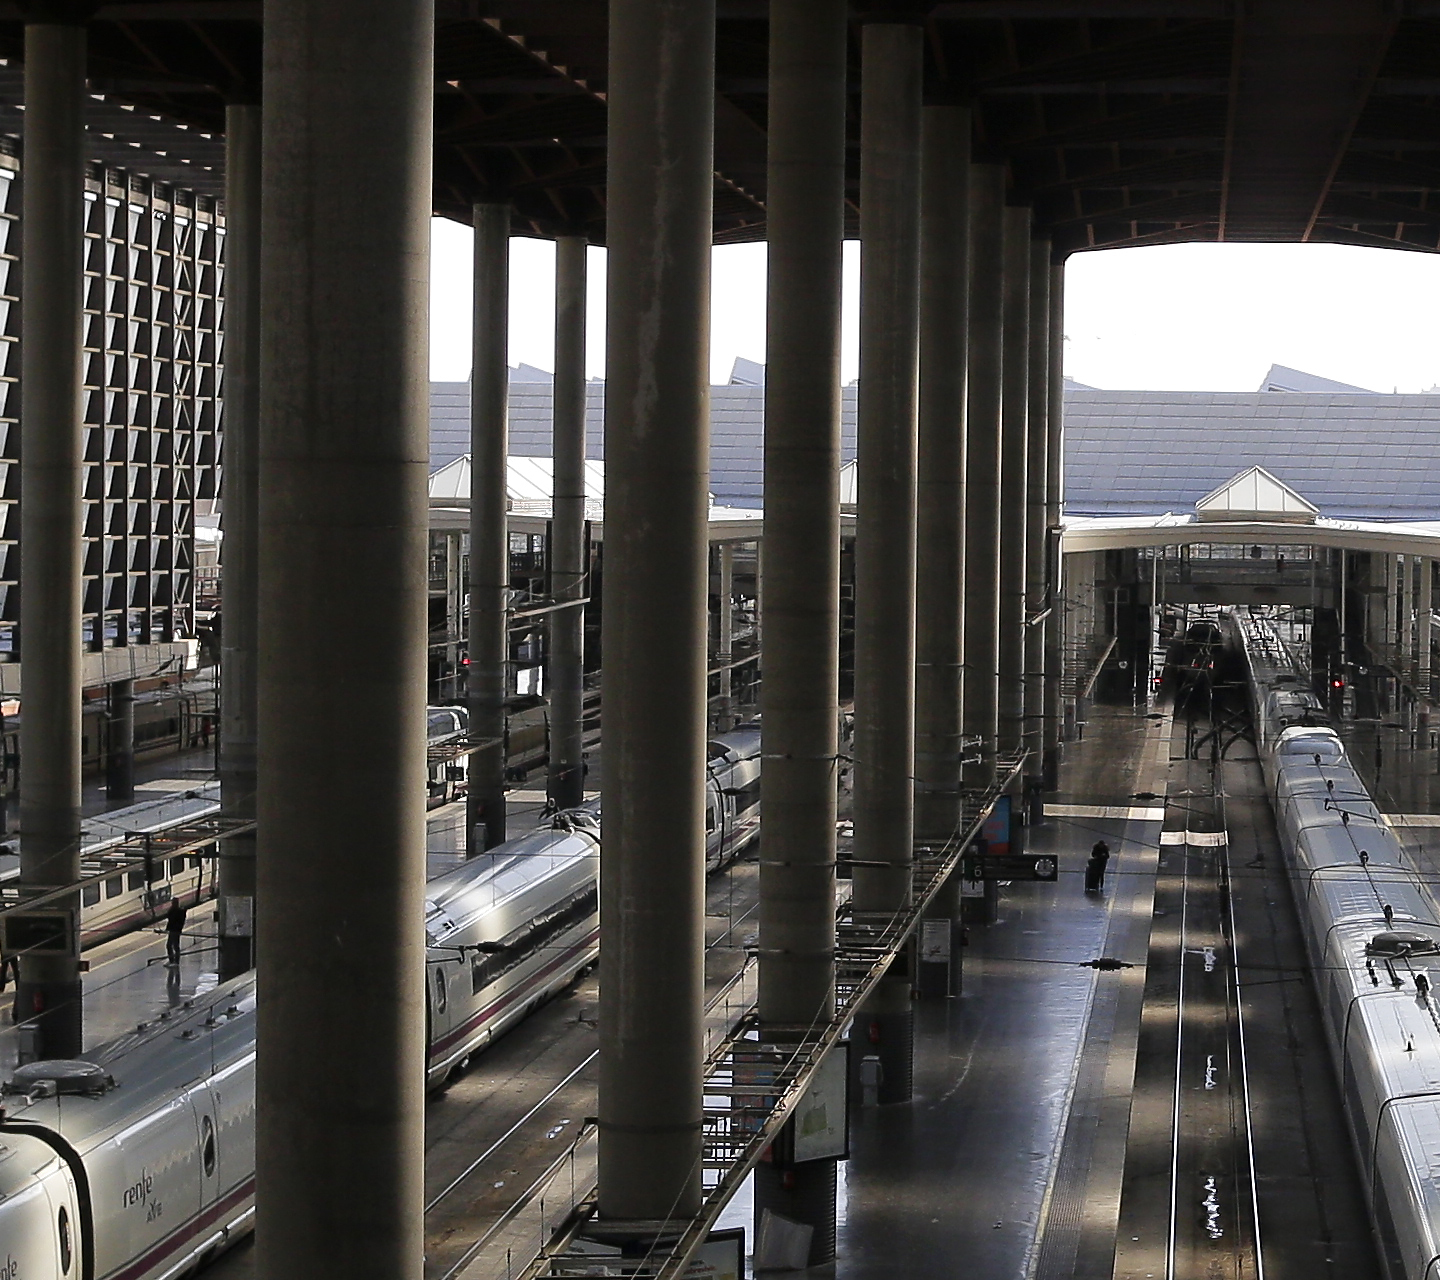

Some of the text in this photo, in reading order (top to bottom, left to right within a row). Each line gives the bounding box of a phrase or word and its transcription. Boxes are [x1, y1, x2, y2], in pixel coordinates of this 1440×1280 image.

[974, 864, 982, 877] 6
[123, 1167, 152, 1208] renfe
[146, 1198, 162, 1222] AVE
